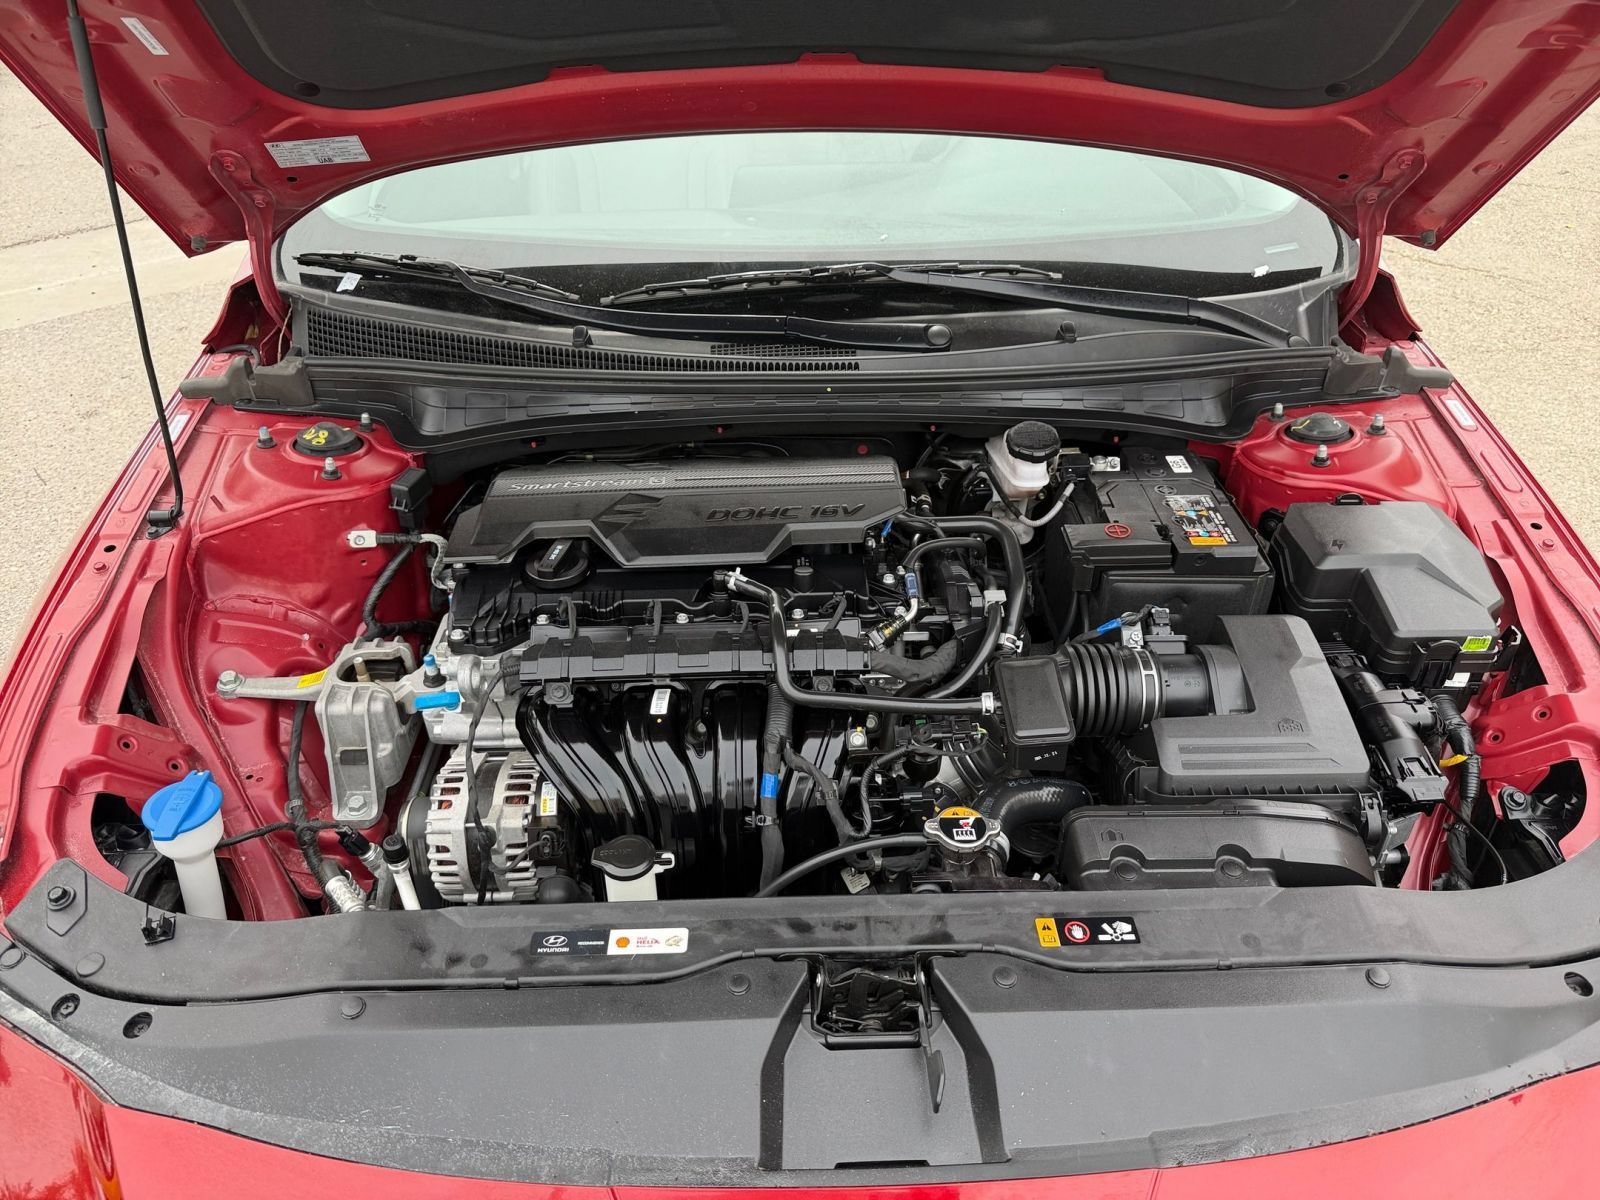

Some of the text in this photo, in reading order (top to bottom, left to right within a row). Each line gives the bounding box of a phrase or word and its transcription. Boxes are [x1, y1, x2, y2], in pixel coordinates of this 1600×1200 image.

[509, 478, 644, 491] Smartstream
[705, 502, 867, 522] DOHC 16V
